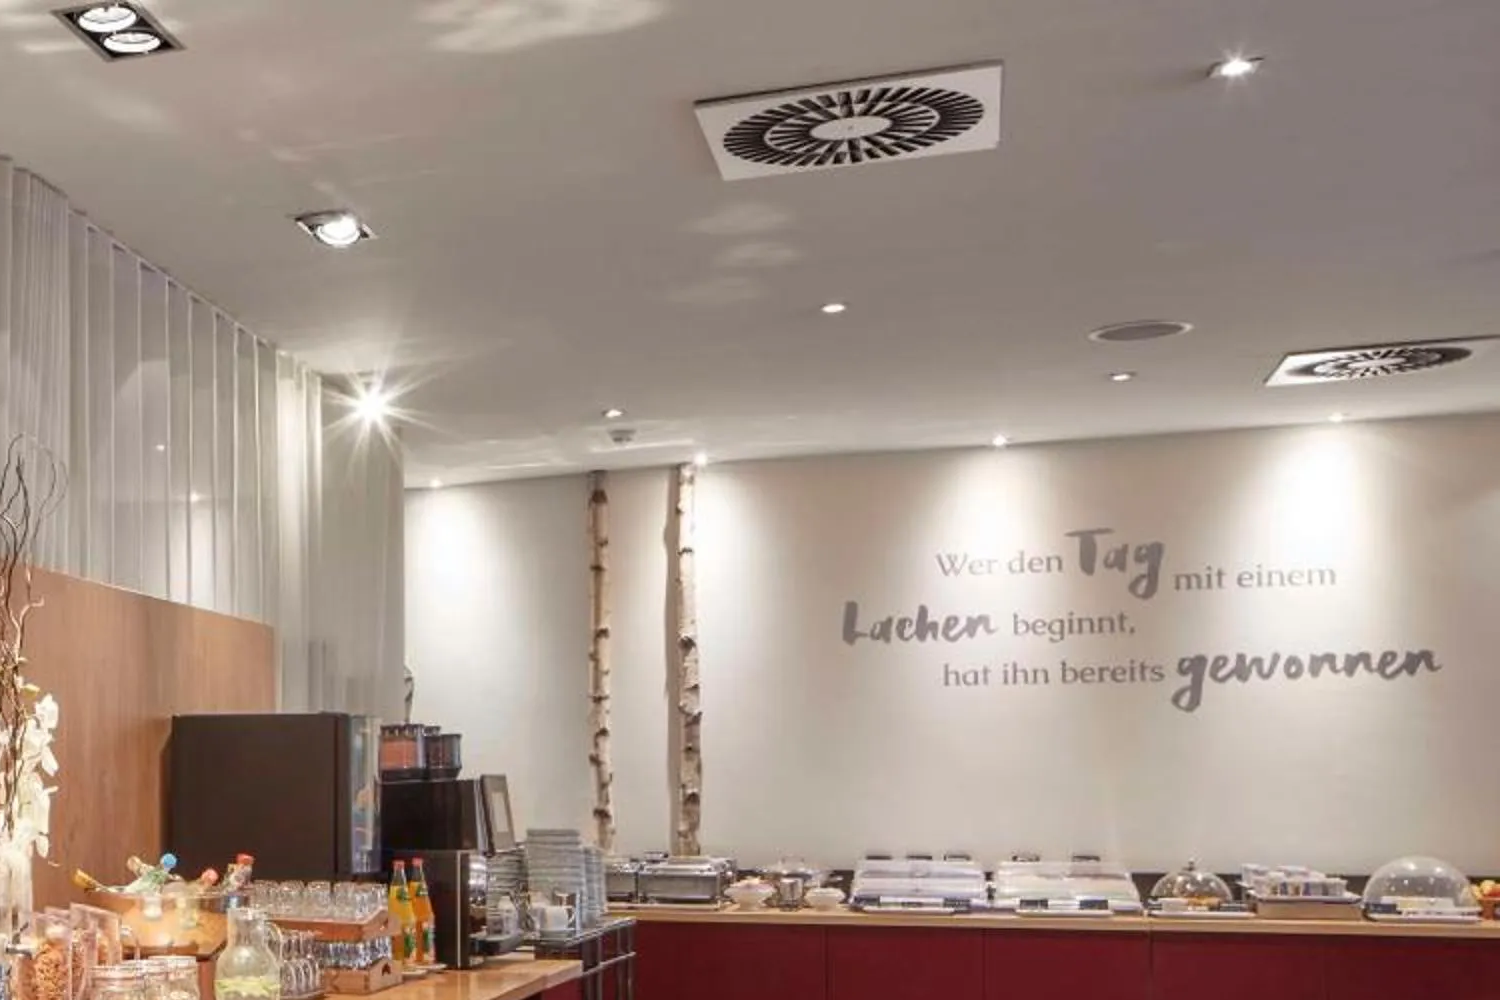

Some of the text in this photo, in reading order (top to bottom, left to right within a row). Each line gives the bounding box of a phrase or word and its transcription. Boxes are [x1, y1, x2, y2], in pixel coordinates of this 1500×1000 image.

[936, 528, 1337, 601] Wer den Tag mit einem
[842, 601, 1136, 647] Lachen beginnt,
[943, 649, 1442, 714] hat ihn bereits gewonnen
